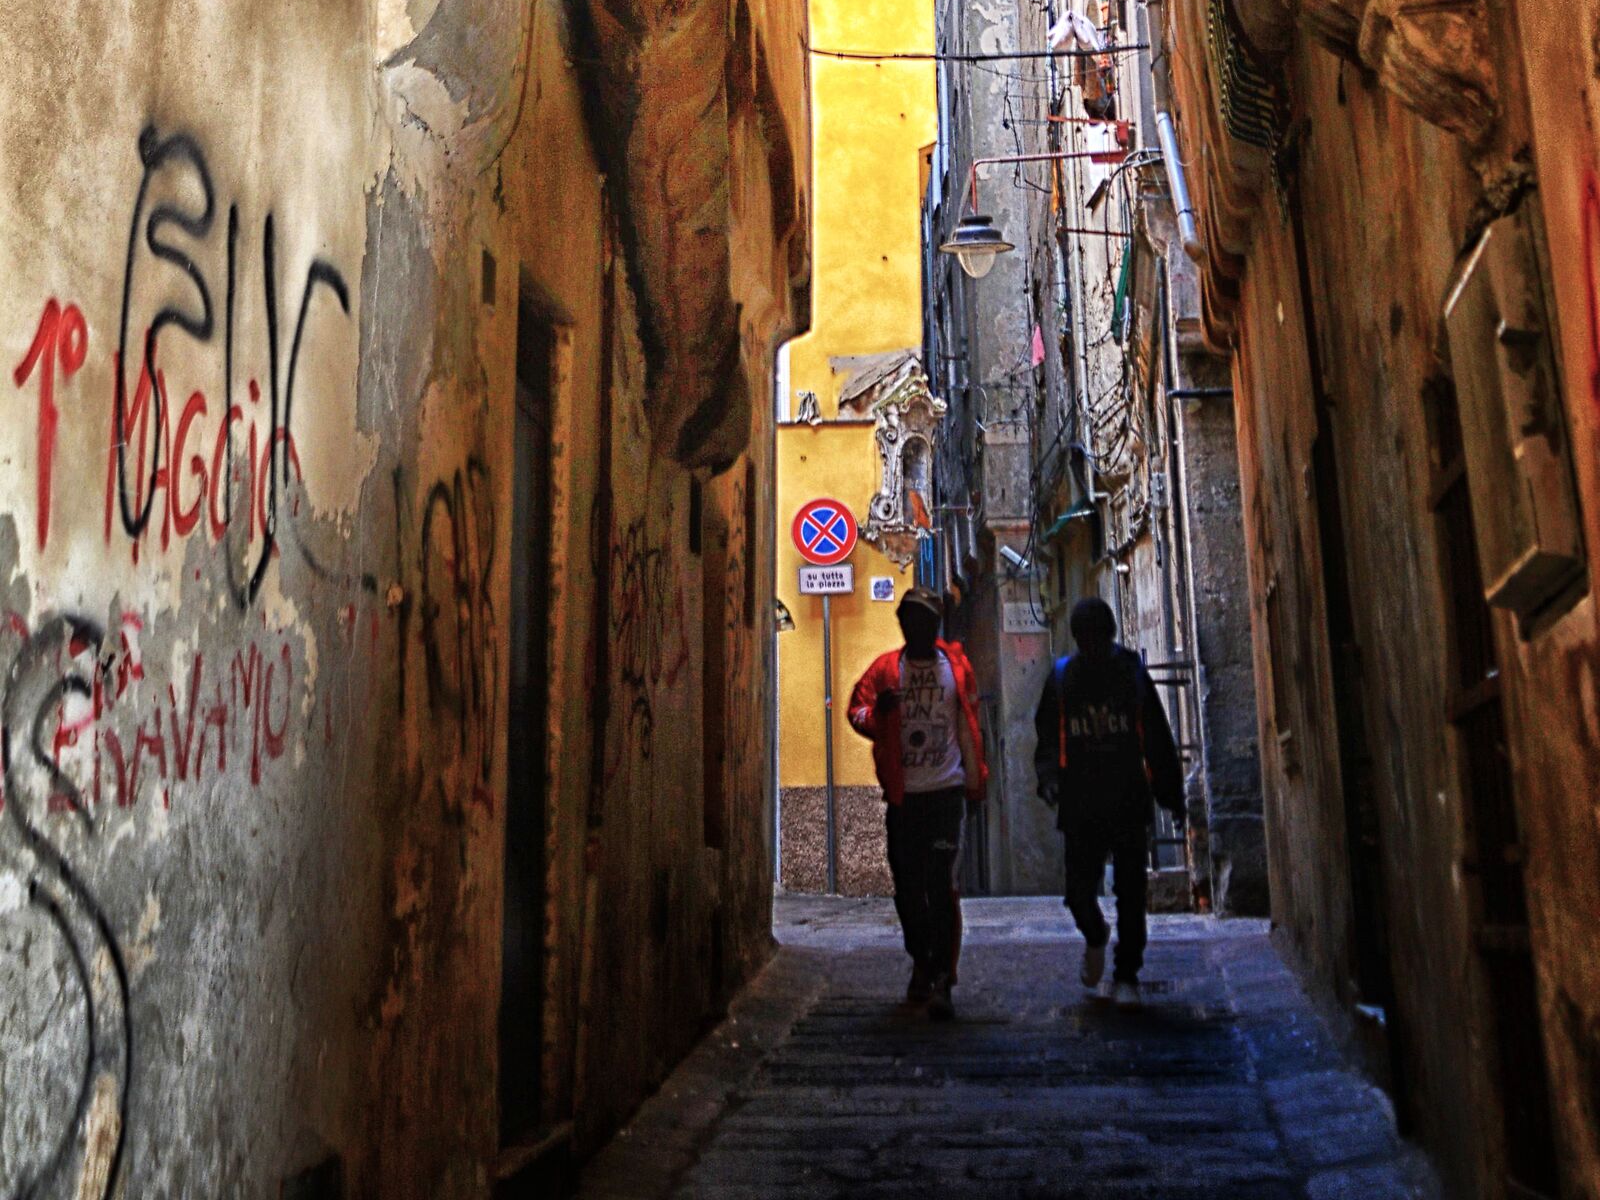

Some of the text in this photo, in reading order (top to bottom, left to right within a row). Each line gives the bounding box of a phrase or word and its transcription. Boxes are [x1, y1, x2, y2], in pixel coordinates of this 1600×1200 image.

[821, 571, 844, 580] tutta
[806, 580, 846, 589] la piazza
[909, 670, 938, 688] MA
